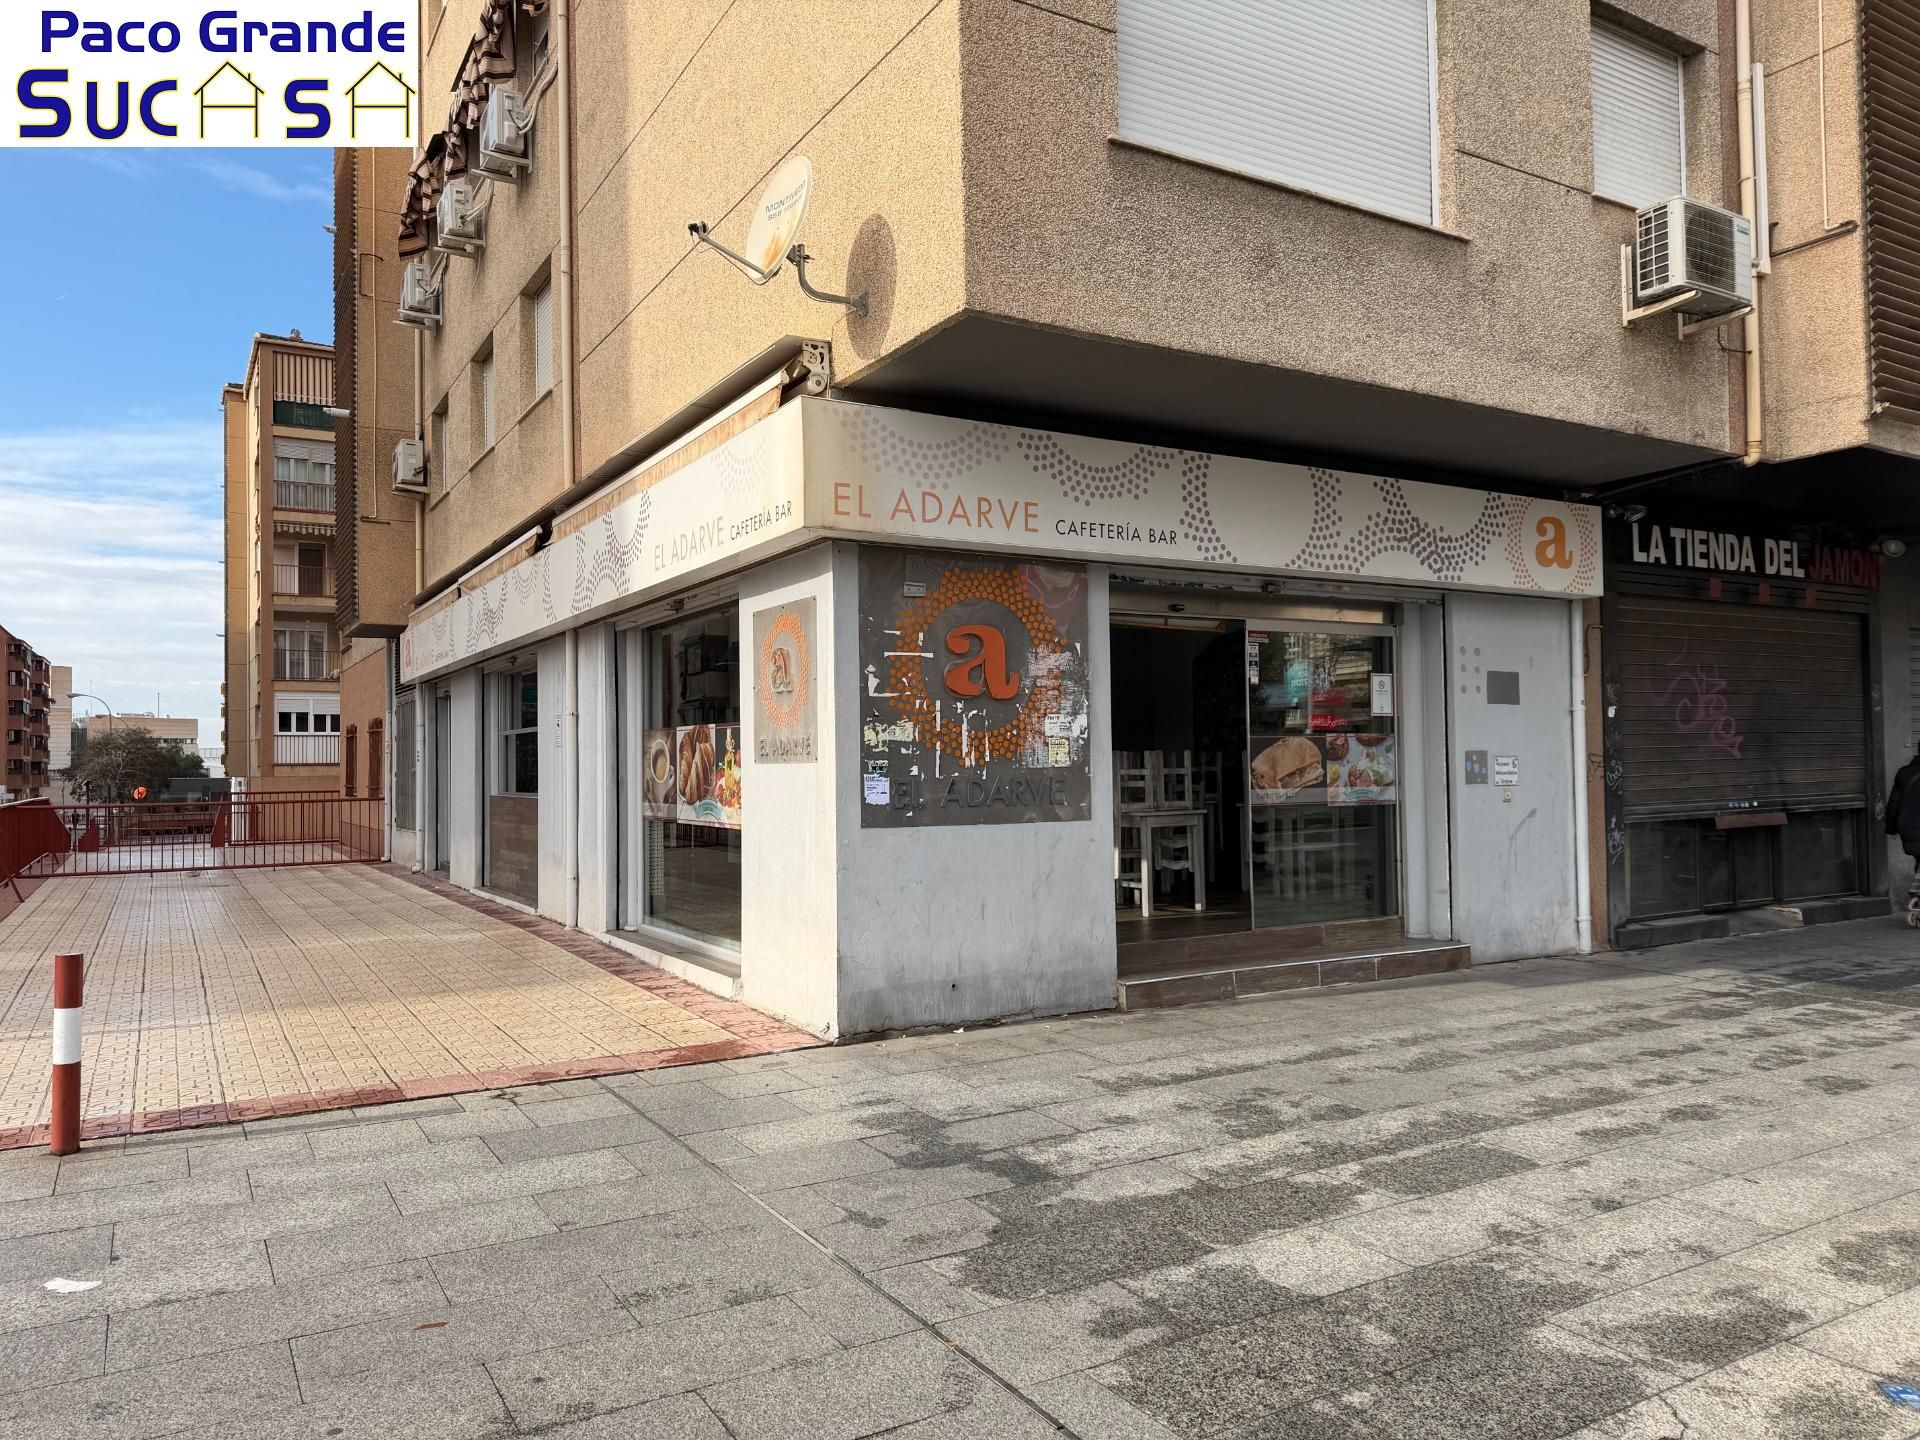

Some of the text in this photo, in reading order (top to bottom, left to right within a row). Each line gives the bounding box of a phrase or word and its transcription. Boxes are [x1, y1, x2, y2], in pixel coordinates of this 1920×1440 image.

[654, 500, 792, 571] EL ADARVE CAFETERÍA BAR
[833, 482, 1178, 546] EL ADARVE CAFETERÍA BAR
[1534, 516, 1573, 569] a
[1631, 522, 1667, 564] LA
[1669, 527, 1757, 573] TIENDA
[1764, 538, 1806, 578] DEL
[944, 624, 1021, 700] a
[891, 778, 925, 810] EL
[940, 775, 1066, 808] ADARVE
